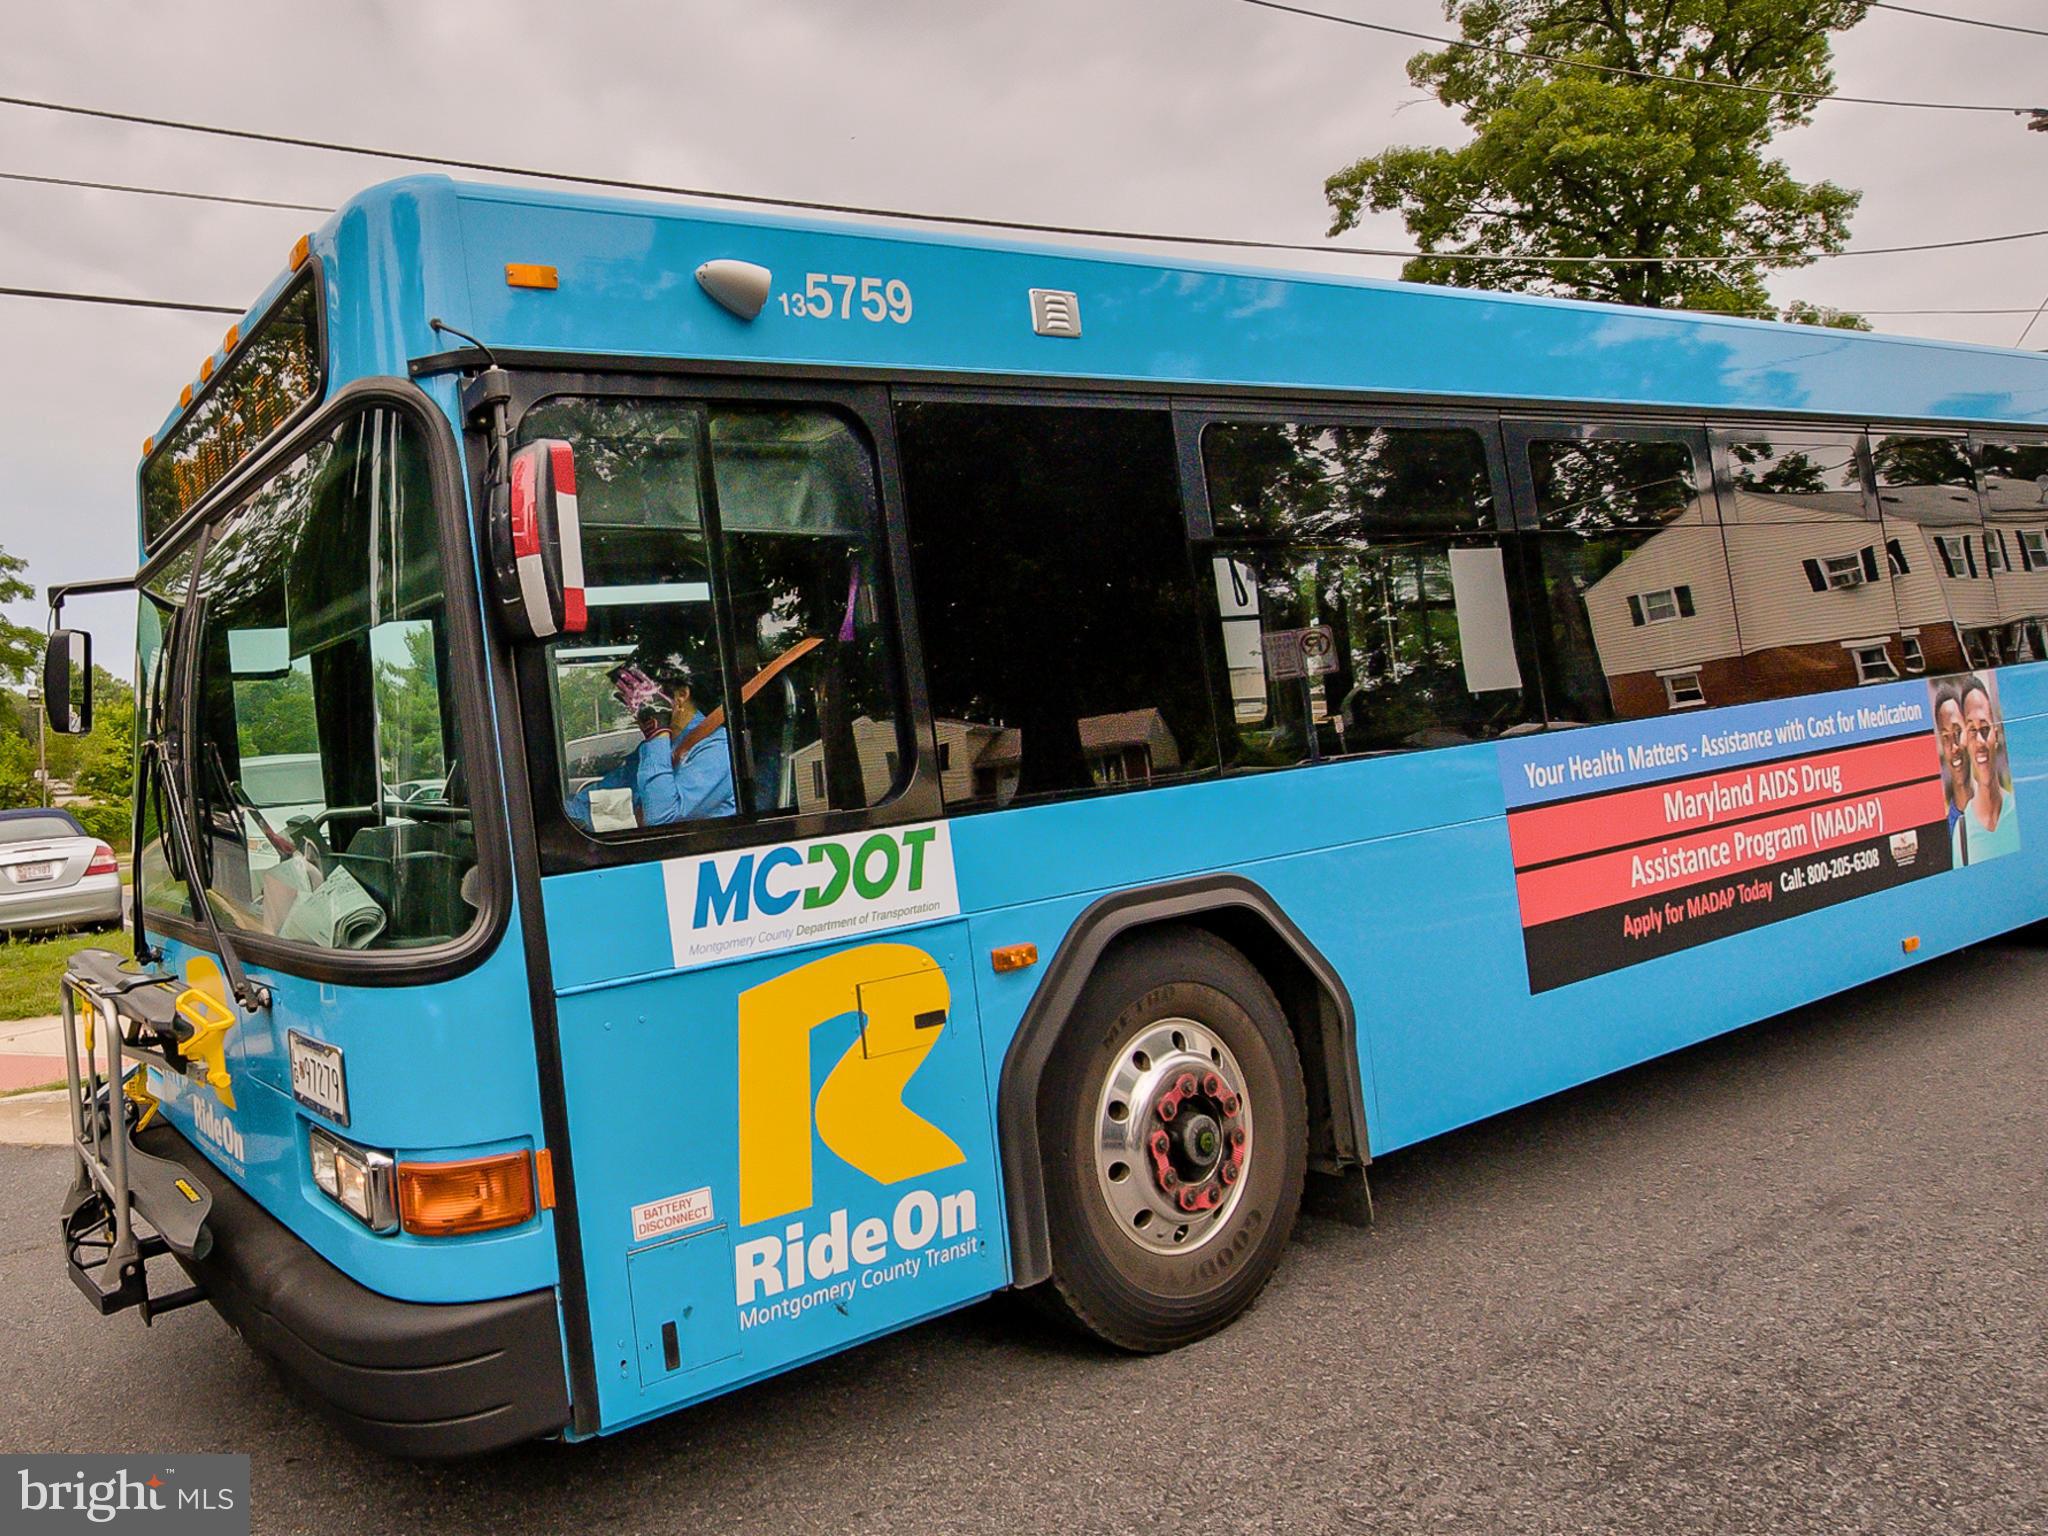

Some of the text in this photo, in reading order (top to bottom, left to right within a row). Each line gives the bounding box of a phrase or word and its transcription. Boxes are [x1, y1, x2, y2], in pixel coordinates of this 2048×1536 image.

[1524, 762, 1565, 789] Your
[1568, 749, 1624, 781] Health
[1627, 739, 1688, 765] Matters
[1701, 728, 1773, 759] Assistance
[1775, 720, 1805, 745] with
[1807, 716, 1836, 739] Cost
[1837, 712, 1856, 733] for
[1858, 702, 1922, 729] Medication
[1663, 764, 1842, 823] Maryland AIDS Drug
[692, 826, 936, 930] MCDOT
[1631, 797, 1884, 888] Assistance Program (MADAP)
[688, 900, 941, 957] Montgomery County Department of Transportation
[1623, 906, 1663, 940] Apply
[1665, 901, 1685, 924] for
[1687, 887, 1736, 919] MADAP
[1737, 879, 1773, 904] Today
[1780, 870, 1806, 893] Call:
[1807, 848, 1880, 885] 800-205-6308
[191, 1093, 244, 1162] RideOn
[639, 1205, 708, 1235] DISCONNECT
[643, 1197, 692, 1221] BATTERY
[735, 1189, 977, 1306] RideOn
[740, 1237, 978, 1331] Montgomery County Transit
